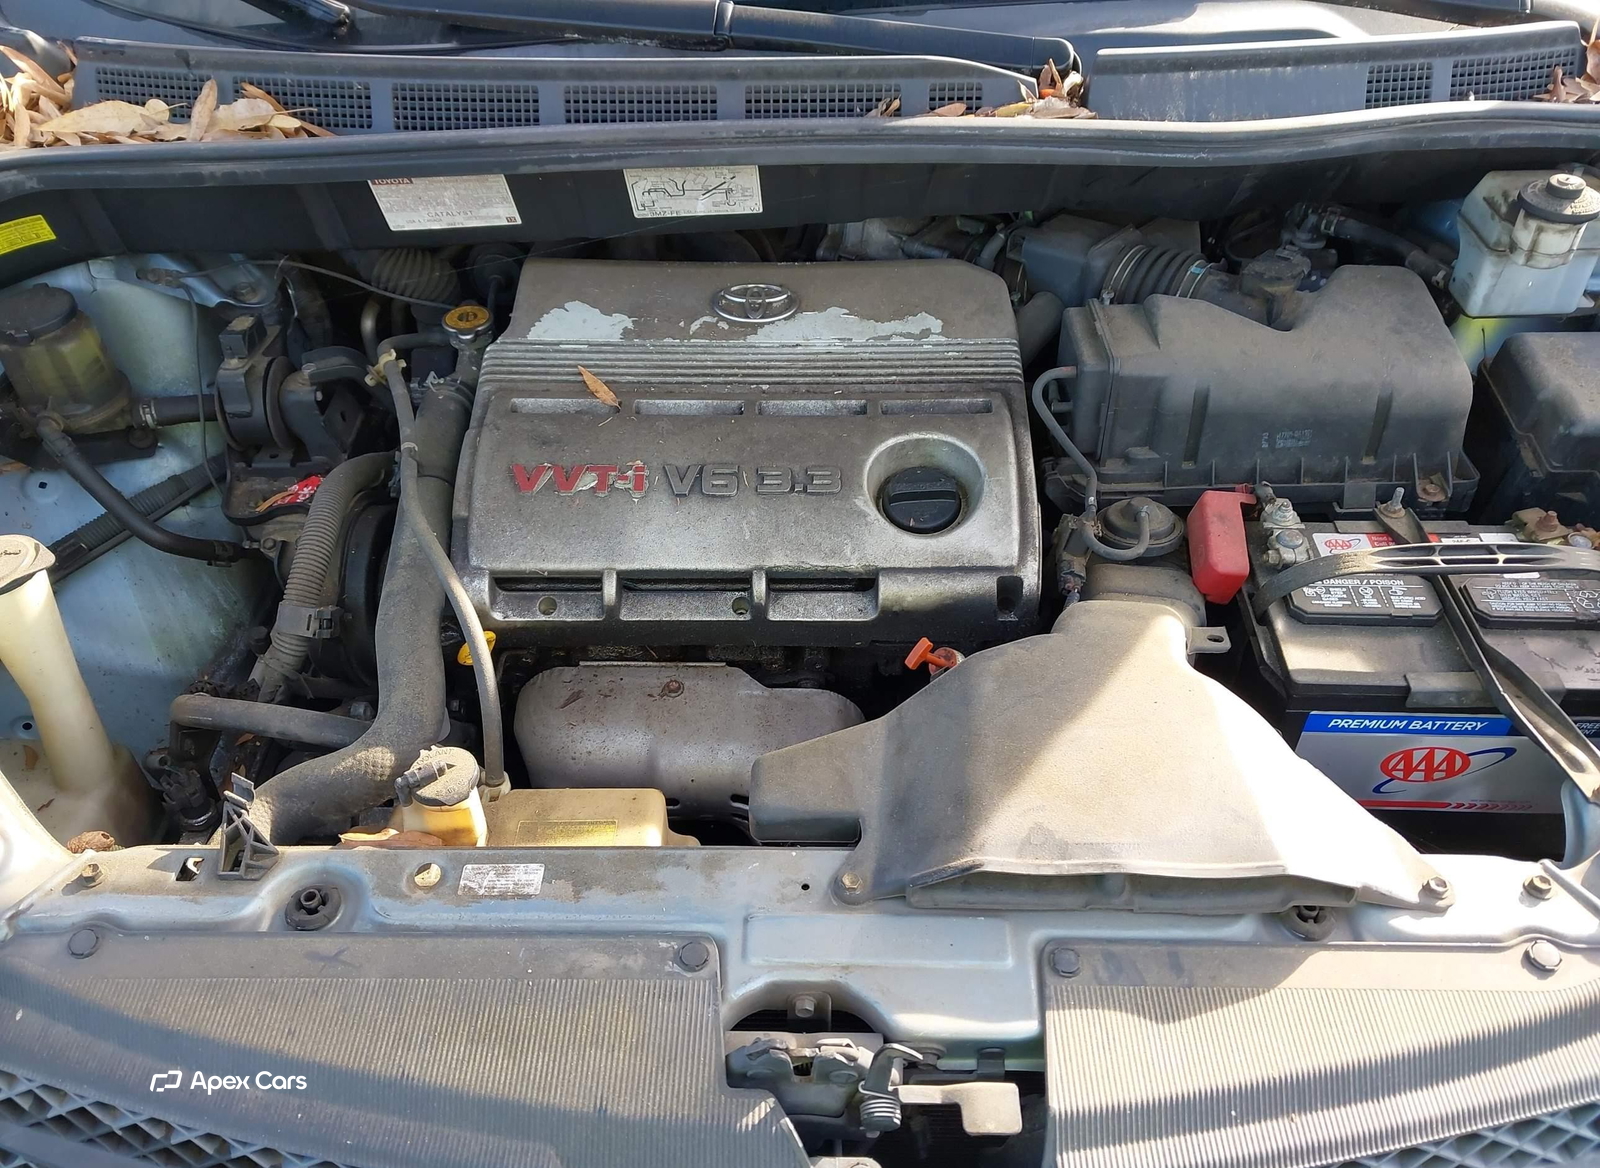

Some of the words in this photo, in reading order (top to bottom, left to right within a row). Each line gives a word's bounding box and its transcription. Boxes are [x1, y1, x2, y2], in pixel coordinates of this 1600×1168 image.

[426, 210, 474, 218] CATALYST
[511, 463, 647, 495] VVT-i
[663, 464, 740, 496] V6
[755, 465, 843, 496] 3.3
[1327, 718, 1411, 730] PREMIUM
[1408, 720, 1490, 731] BATTERY
[1385, 747, 1463, 782] AAA
